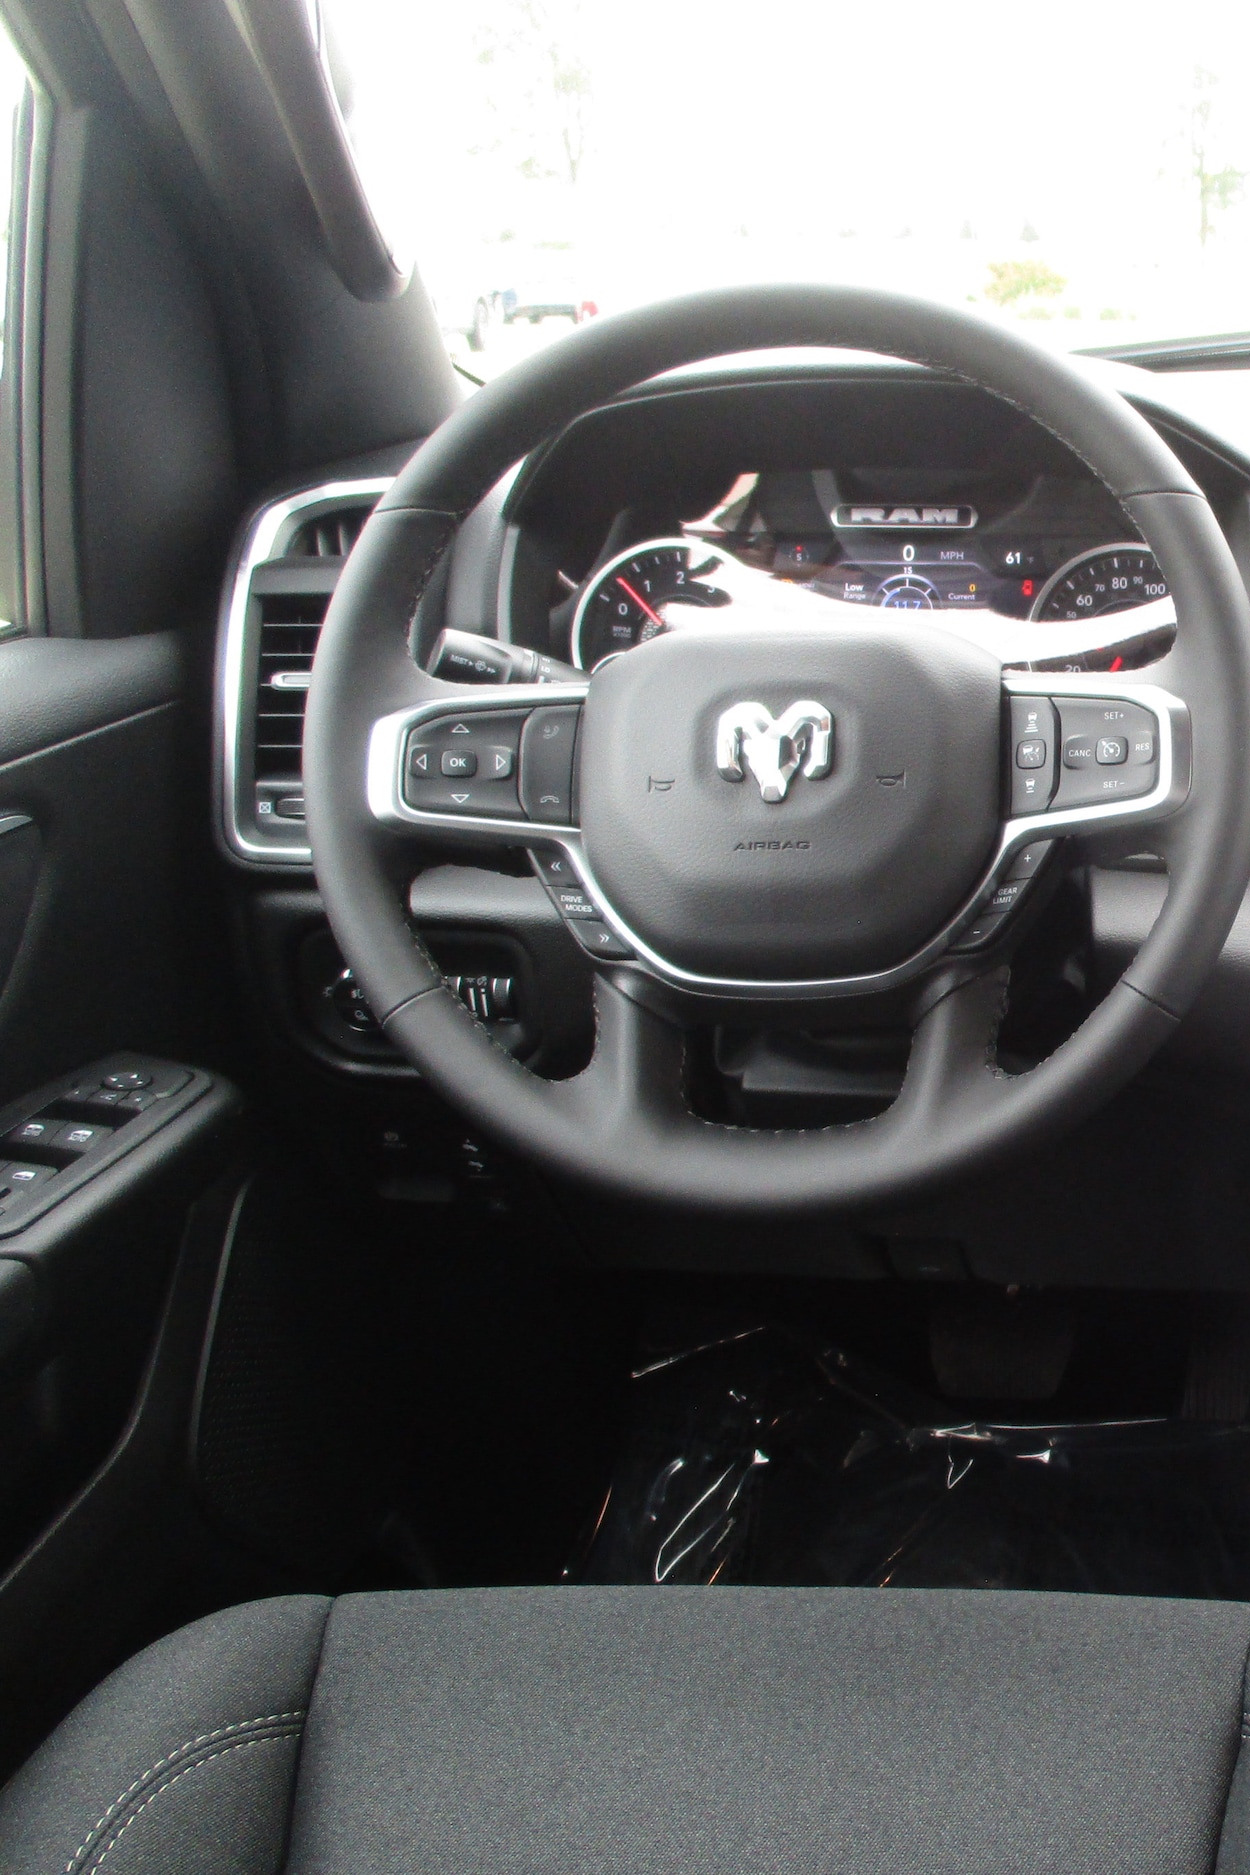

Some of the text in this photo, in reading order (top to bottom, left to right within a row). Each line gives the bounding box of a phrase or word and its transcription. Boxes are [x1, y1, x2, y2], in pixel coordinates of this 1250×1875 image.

[851, 508, 959, 524] RAM
[903, 545, 964, 561] 0 MPH
[1005, 552, 1021, 564] 61
[676, 571, 685, 584] 2
[1133, 577, 1143, 585] 90
[644, 580, 651, 592] 1
[845, 582, 864, 591] Low
[1095, 584, 1105, 592] 70
[1112, 577, 1128, 589] 80
[1144, 584, 1166, 595] 100
[1076, 595, 1093, 606] 60
[618, 603, 628, 615] 0
[1066, 611, 1077, 619] 50
[1135, 743, 1150, 751] RES
[450, 758, 466, 767] OK
[733, 841, 812, 851] AIRBAG
[998, 887, 1018, 896] GEAR
[561, 895, 582, 903] DRIVE
[566, 904, 592, 912] MODES
